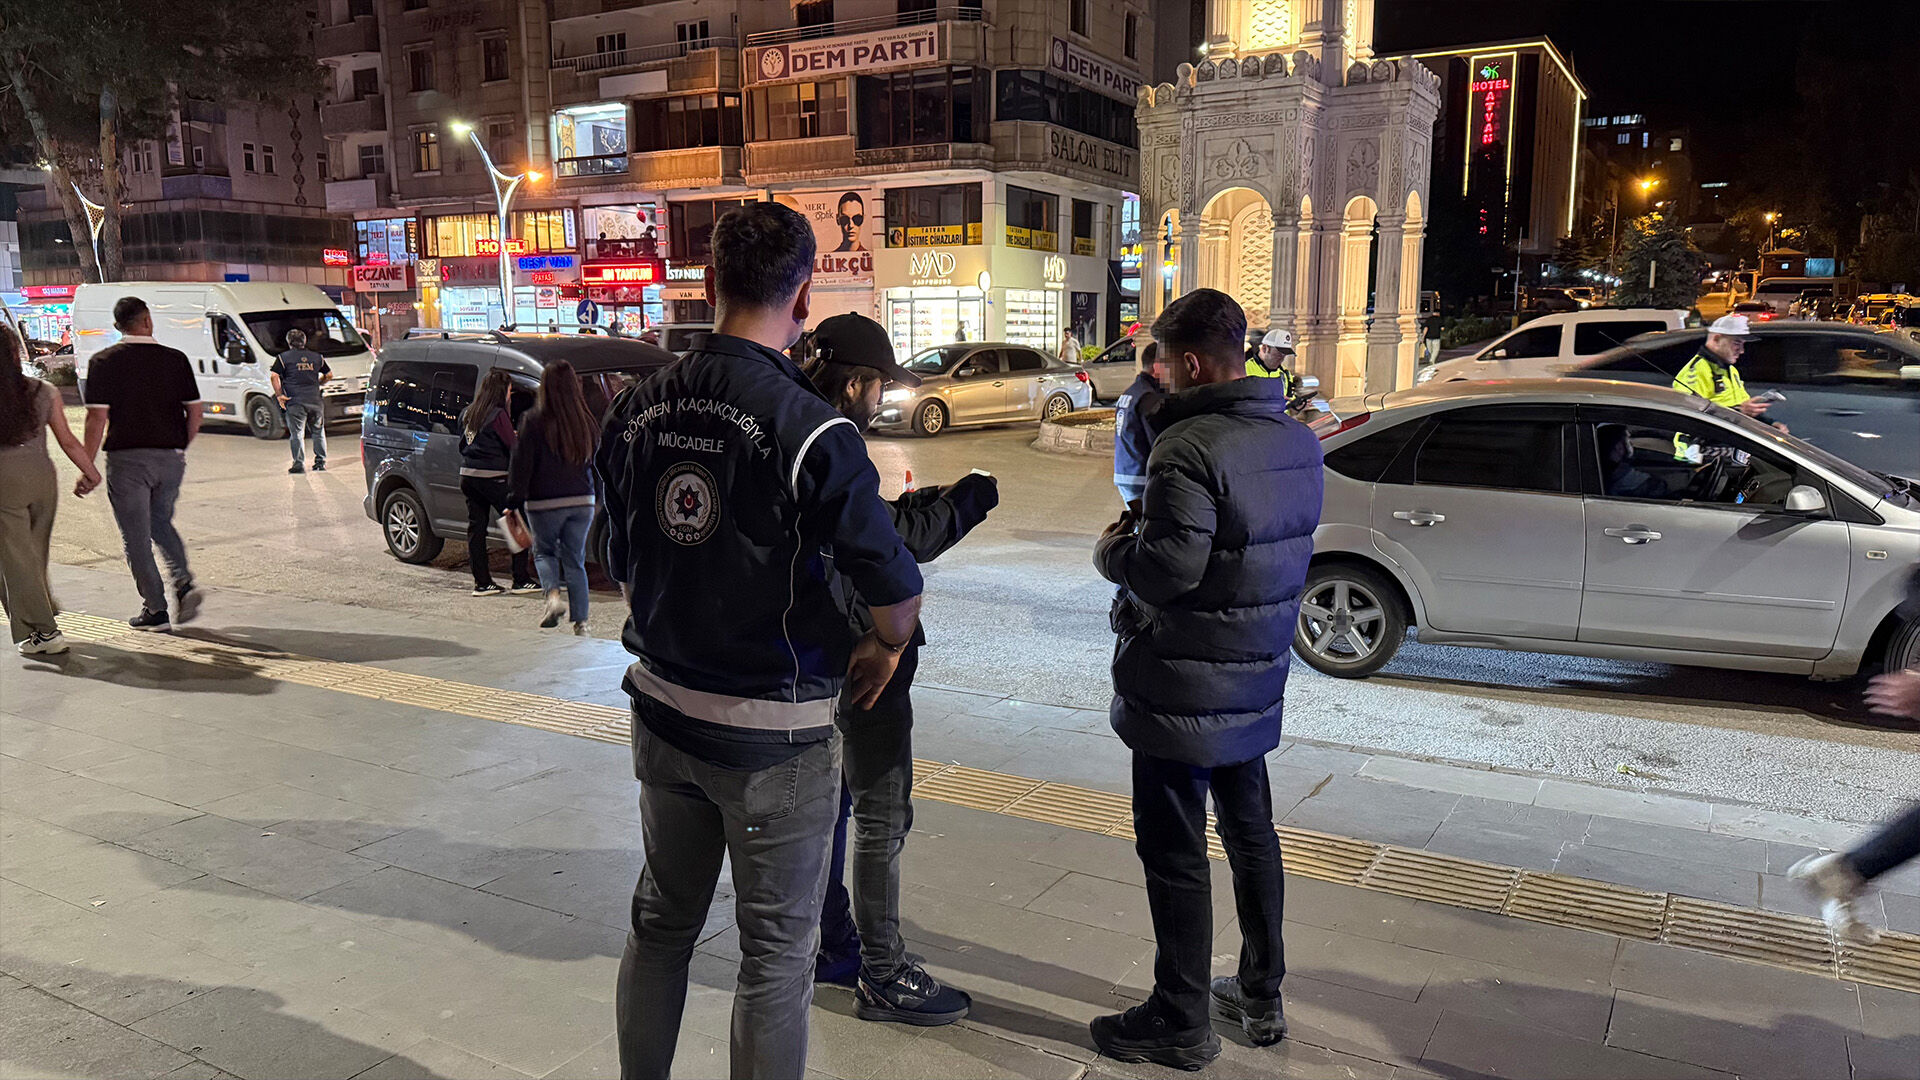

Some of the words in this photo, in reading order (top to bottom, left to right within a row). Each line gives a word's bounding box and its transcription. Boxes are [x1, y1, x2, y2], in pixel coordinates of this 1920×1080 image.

[792, 49, 845, 73] DEM
[853, 31, 935, 66] PARTİ
[1068, 54, 1101, 84] DEM
[1472, 79, 1510, 92] HOTEL
[1051, 131, 1098, 169] SALON
[804, 202, 827, 211] MERT
[477, 240, 524, 254] HOEL
[519, 256, 547, 270] BEST
[547, 255, 573, 269] VAN
[813, 252, 874, 276] LÜKÇÜ
[356, 266, 403, 281] ECZANE
[296, 362, 314, 371] TEM
[622, 400, 671, 443] GÖÇMEN
[657, 431, 725, 453] MÜCADELE
[678, 525, 694, 533] EGM
